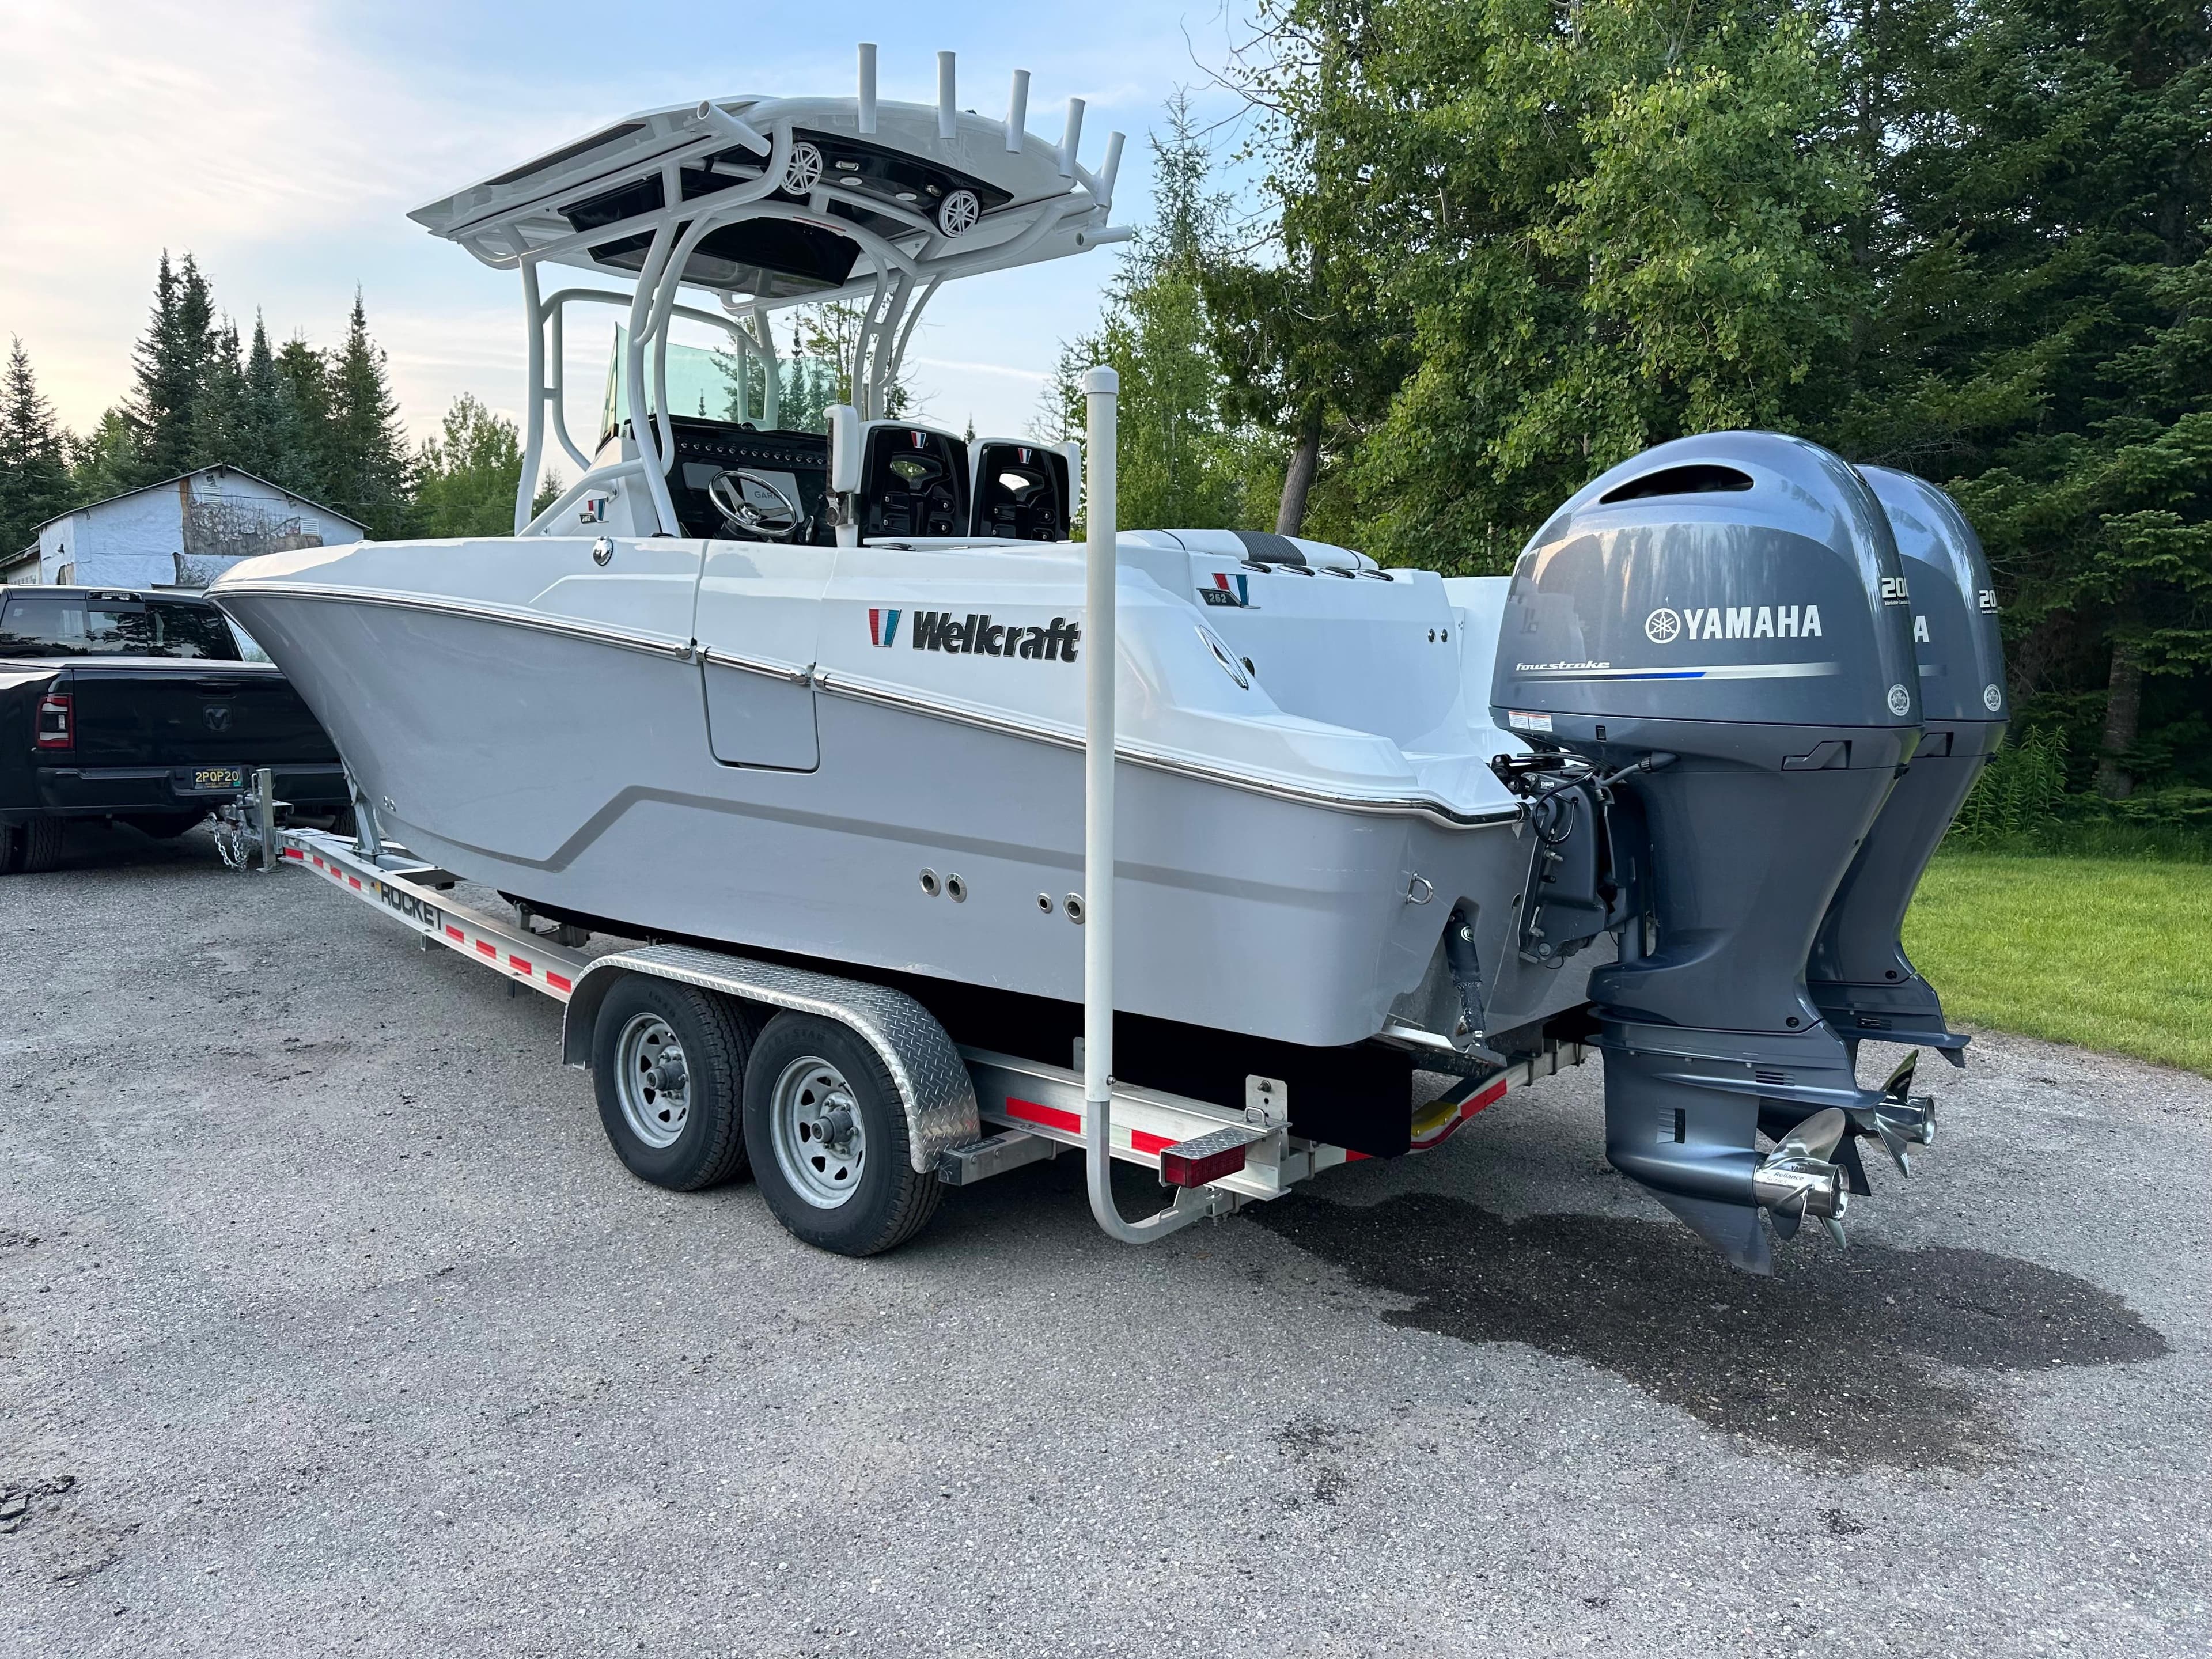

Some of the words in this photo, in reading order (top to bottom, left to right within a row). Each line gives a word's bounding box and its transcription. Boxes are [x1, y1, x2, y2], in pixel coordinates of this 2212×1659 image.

[753, 491, 791, 500] GARN
[1209, 593, 1227, 603] 262
[1881, 577, 1909, 599] 20
[1683, 605, 1823, 640] YAMAHA
[912, 611, 1082, 663] Wellcraft
[380, 881, 444, 930] ROCKET
[1774, 1172, 1805, 1181] Reliance
